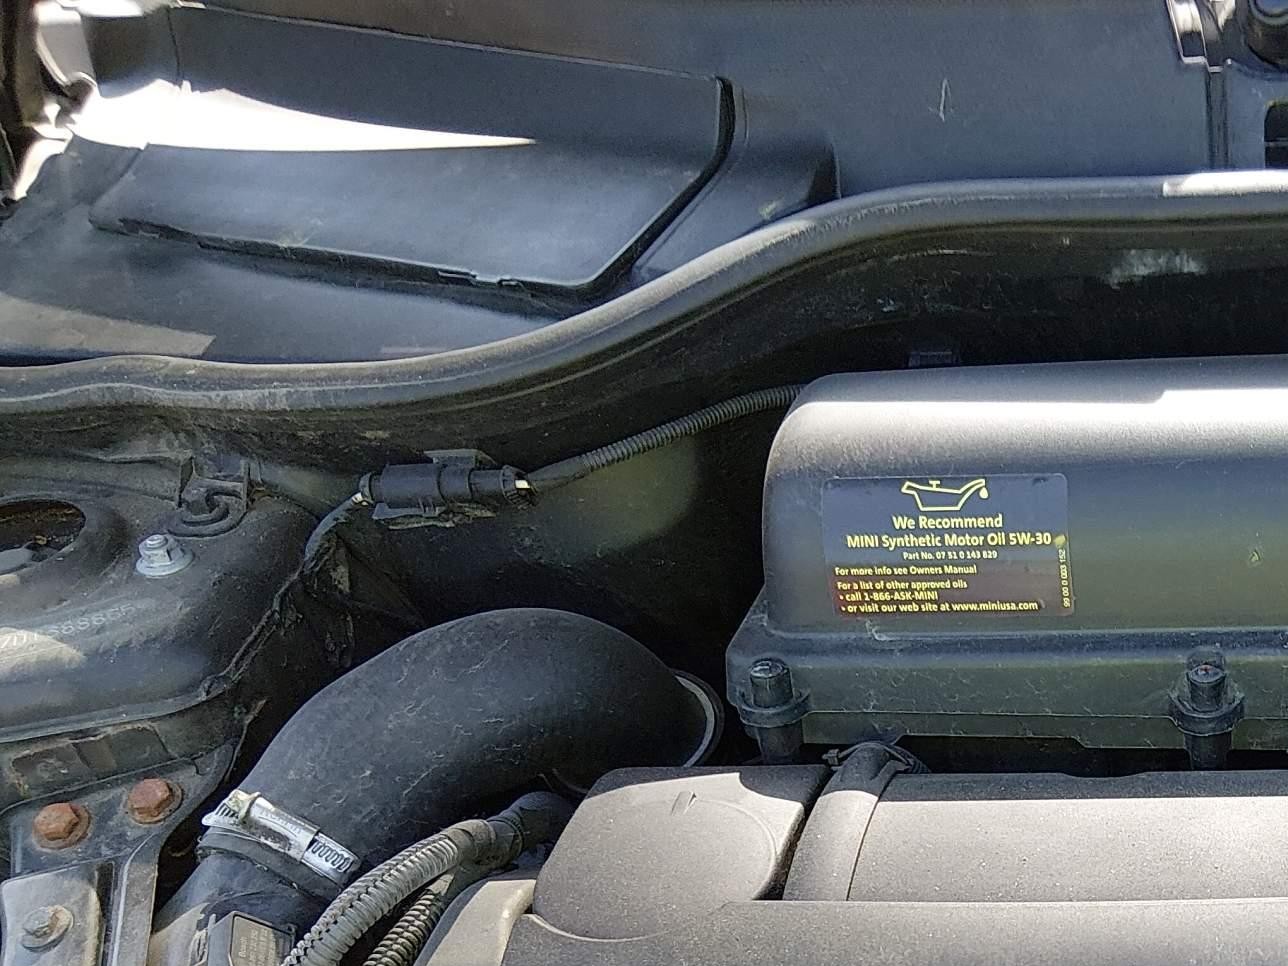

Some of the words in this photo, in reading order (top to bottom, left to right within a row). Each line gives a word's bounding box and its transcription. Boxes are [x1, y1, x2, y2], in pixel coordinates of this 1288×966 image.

[893, 516, 915, 529] We
[919, 514, 1002, 528] Recommend
[847, 535, 878, 547] MINI
[882, 534, 941, 550] Synthetic
[945, 534, 984, 546] Motor
[987, 533, 1005, 545] Oil
[1009, 532, 1051, 545] 5W-30
[921, 551, 934, 559] No.
[936, 551, 945, 559] 07
[959, 551, 964, 559] 0
[835, 567, 848, 575] For
[874, 566, 892, 574] info
[910, 566, 942, 574] Owners
[944, 564, 976, 573] Manual
[860, 581, 873, 589] list
[875, 581, 884, 589] of
[886, 580, 909, 589] other
[911, 580, 950, 591] approved
[952, 580, 967, 588] oils
[846, 592, 862, 601] call
[864, 591, 938, 600] 1-866-ASK-MINI
[859, 603, 879, 612] visit
[899, 602, 919, 611] web
[921, 603, 937, 611] site
[940, 603, 950, 611] at
[952, 601, 1038, 610] www.miniusa.com
